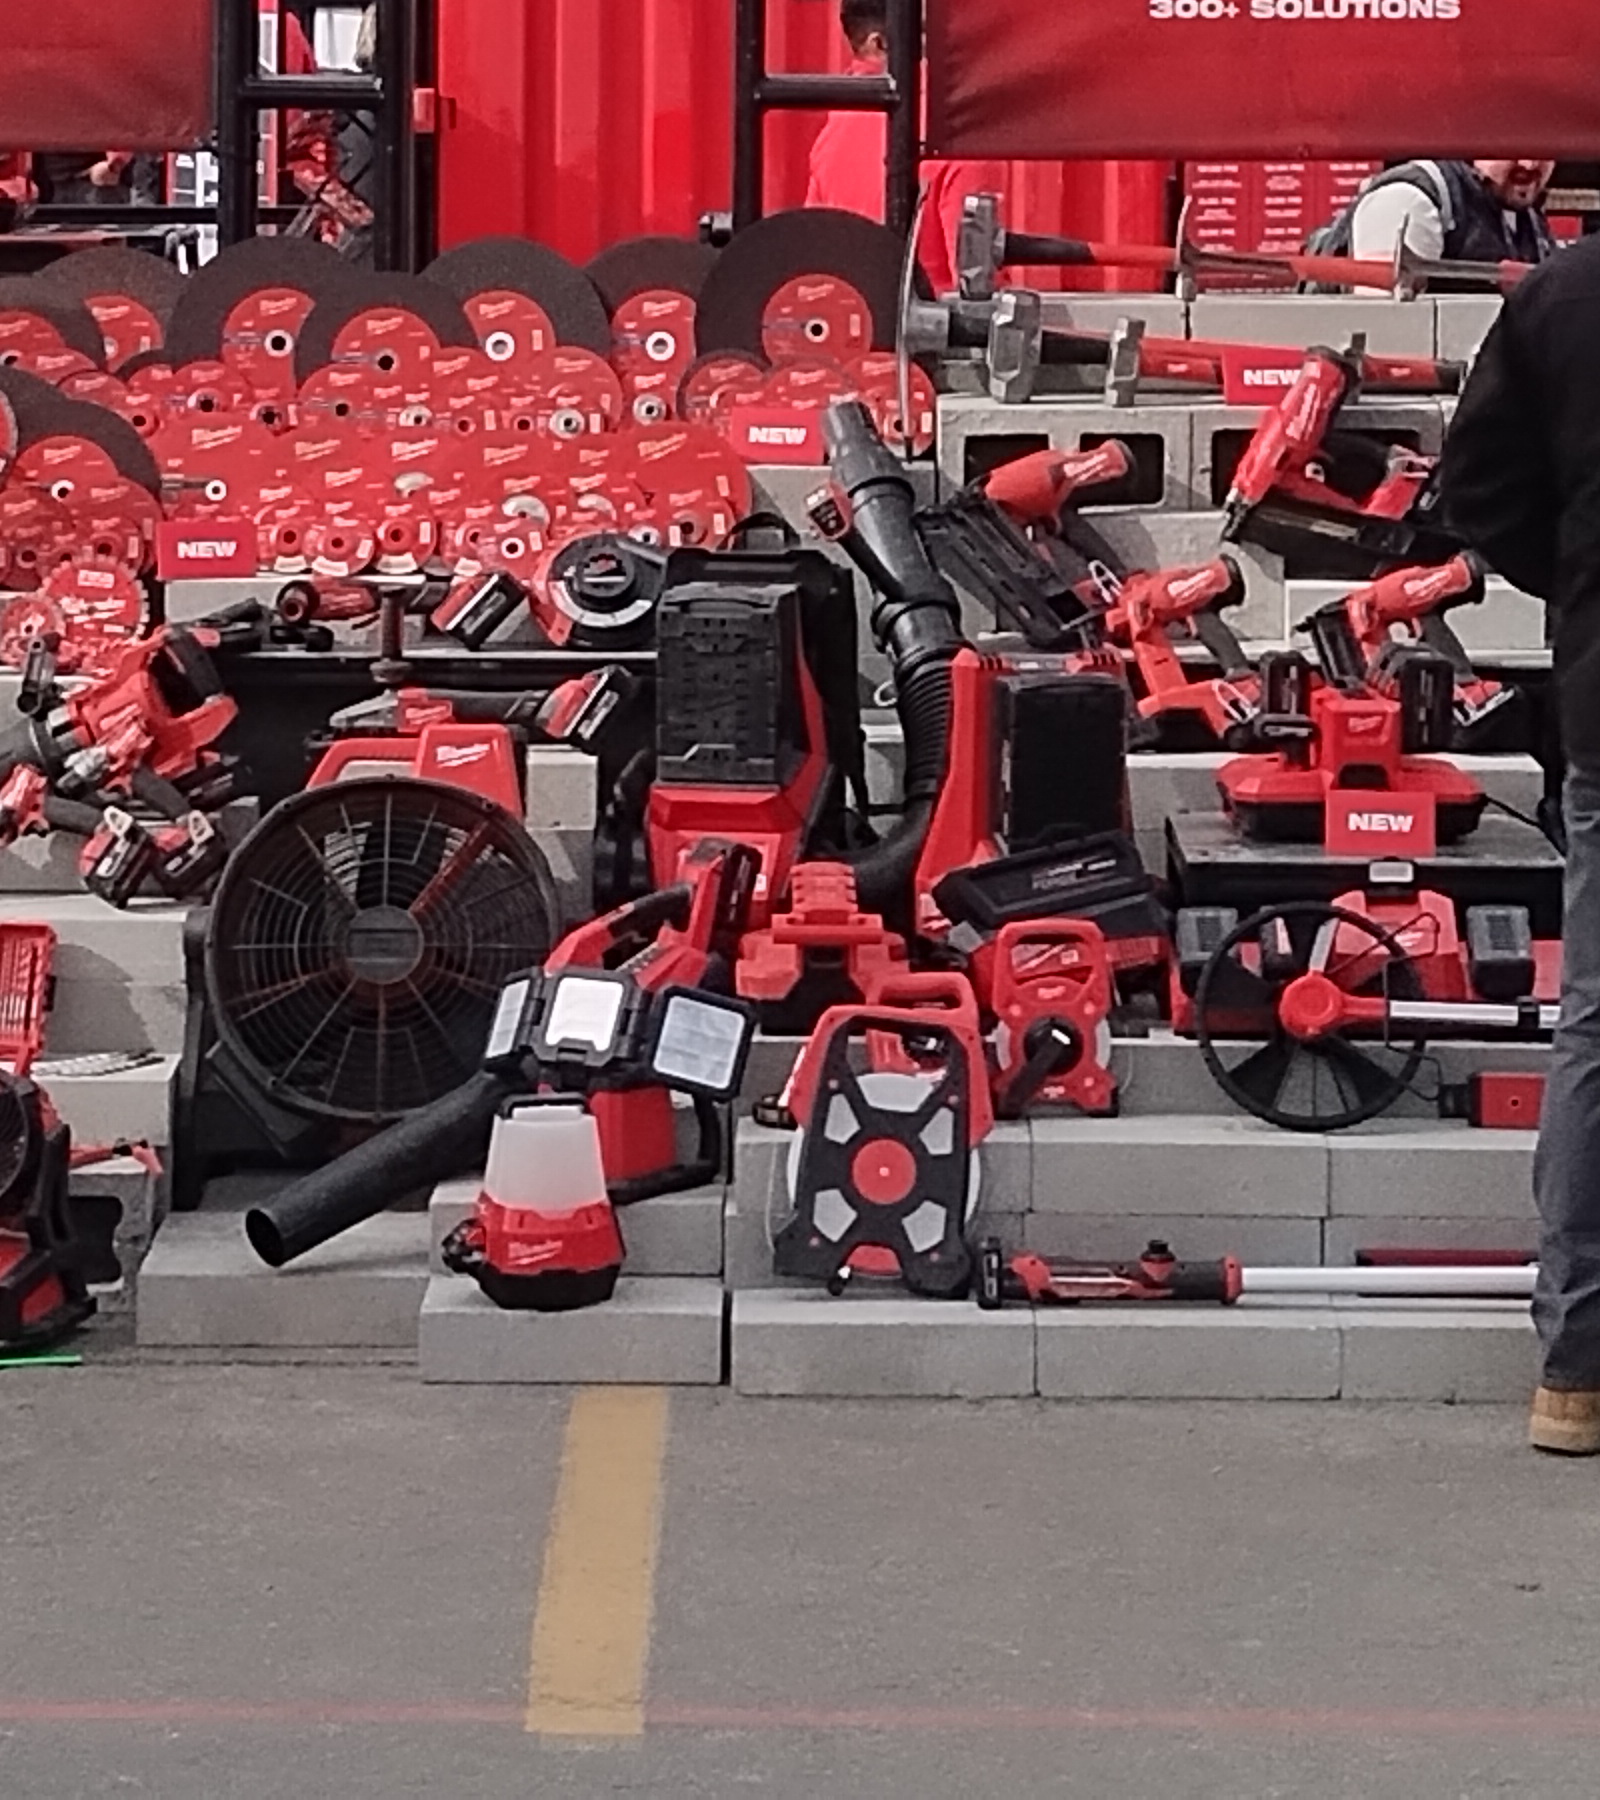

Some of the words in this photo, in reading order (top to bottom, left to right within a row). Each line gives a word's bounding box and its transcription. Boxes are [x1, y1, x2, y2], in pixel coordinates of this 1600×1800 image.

[1243, 368, 1300, 387] NEW
[749, 427, 806, 444] NEW
[178, 542, 236, 558] NEW
[1349, 813, 1413, 832] NEW
